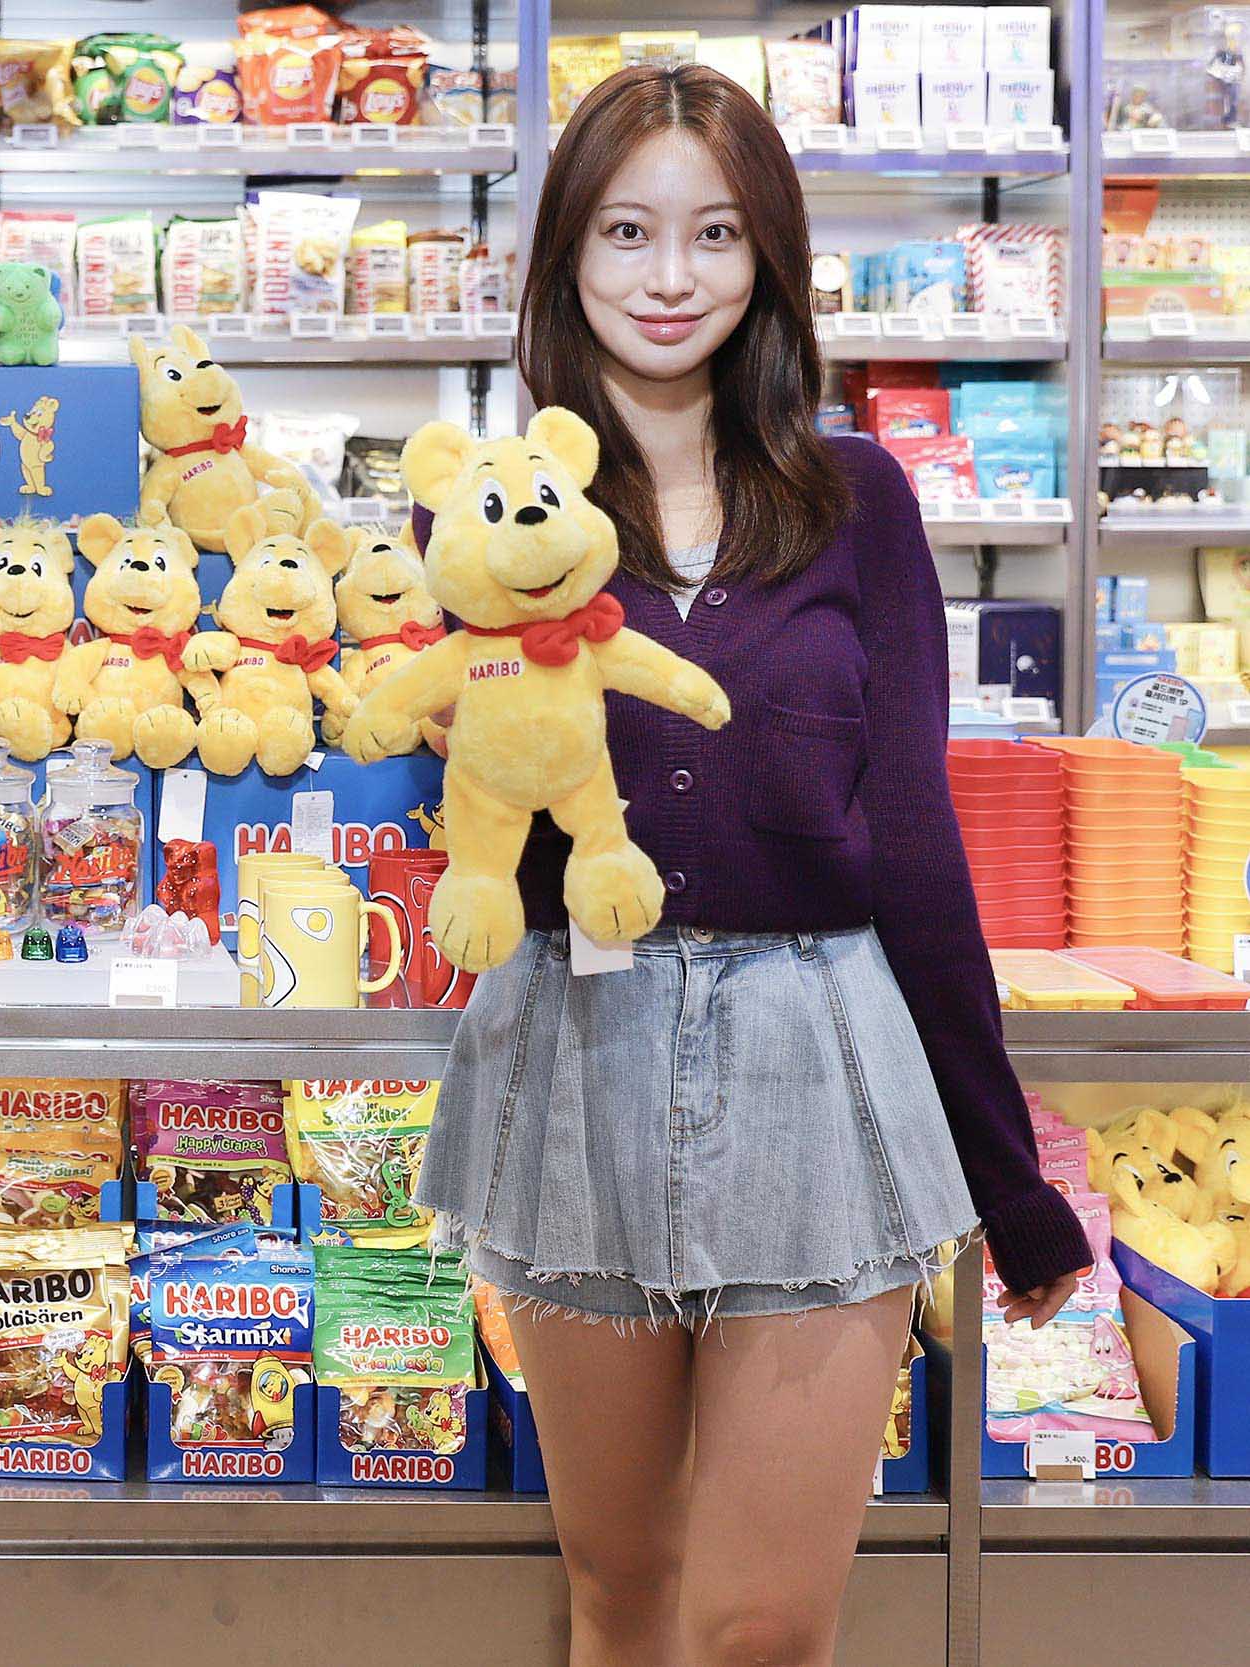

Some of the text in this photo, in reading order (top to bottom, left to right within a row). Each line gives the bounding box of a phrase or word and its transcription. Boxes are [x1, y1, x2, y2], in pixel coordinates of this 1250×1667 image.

[469, 661, 521, 682] HARIBO
[236, 825, 405, 865] HAIBO
[161, 1104, 284, 1134] HARIBO
[178, 1136, 265, 1153] Happy Grapes
[212, 1231, 236, 1243] Share
[270, 1264, 296, 1274] Share
[166, 1284, 297, 1316] HARIBO
[180, 1321, 286, 1346] Starmix
[342, 1327, 450, 1348] HARIBO
[352, 1350, 445, 1374] Phantasia
[183, 1452, 283, 1476] HARIBO
[353, 1455, 452, 1481] HARIBO
[1064, 1456, 1090, 1464] 5,400
